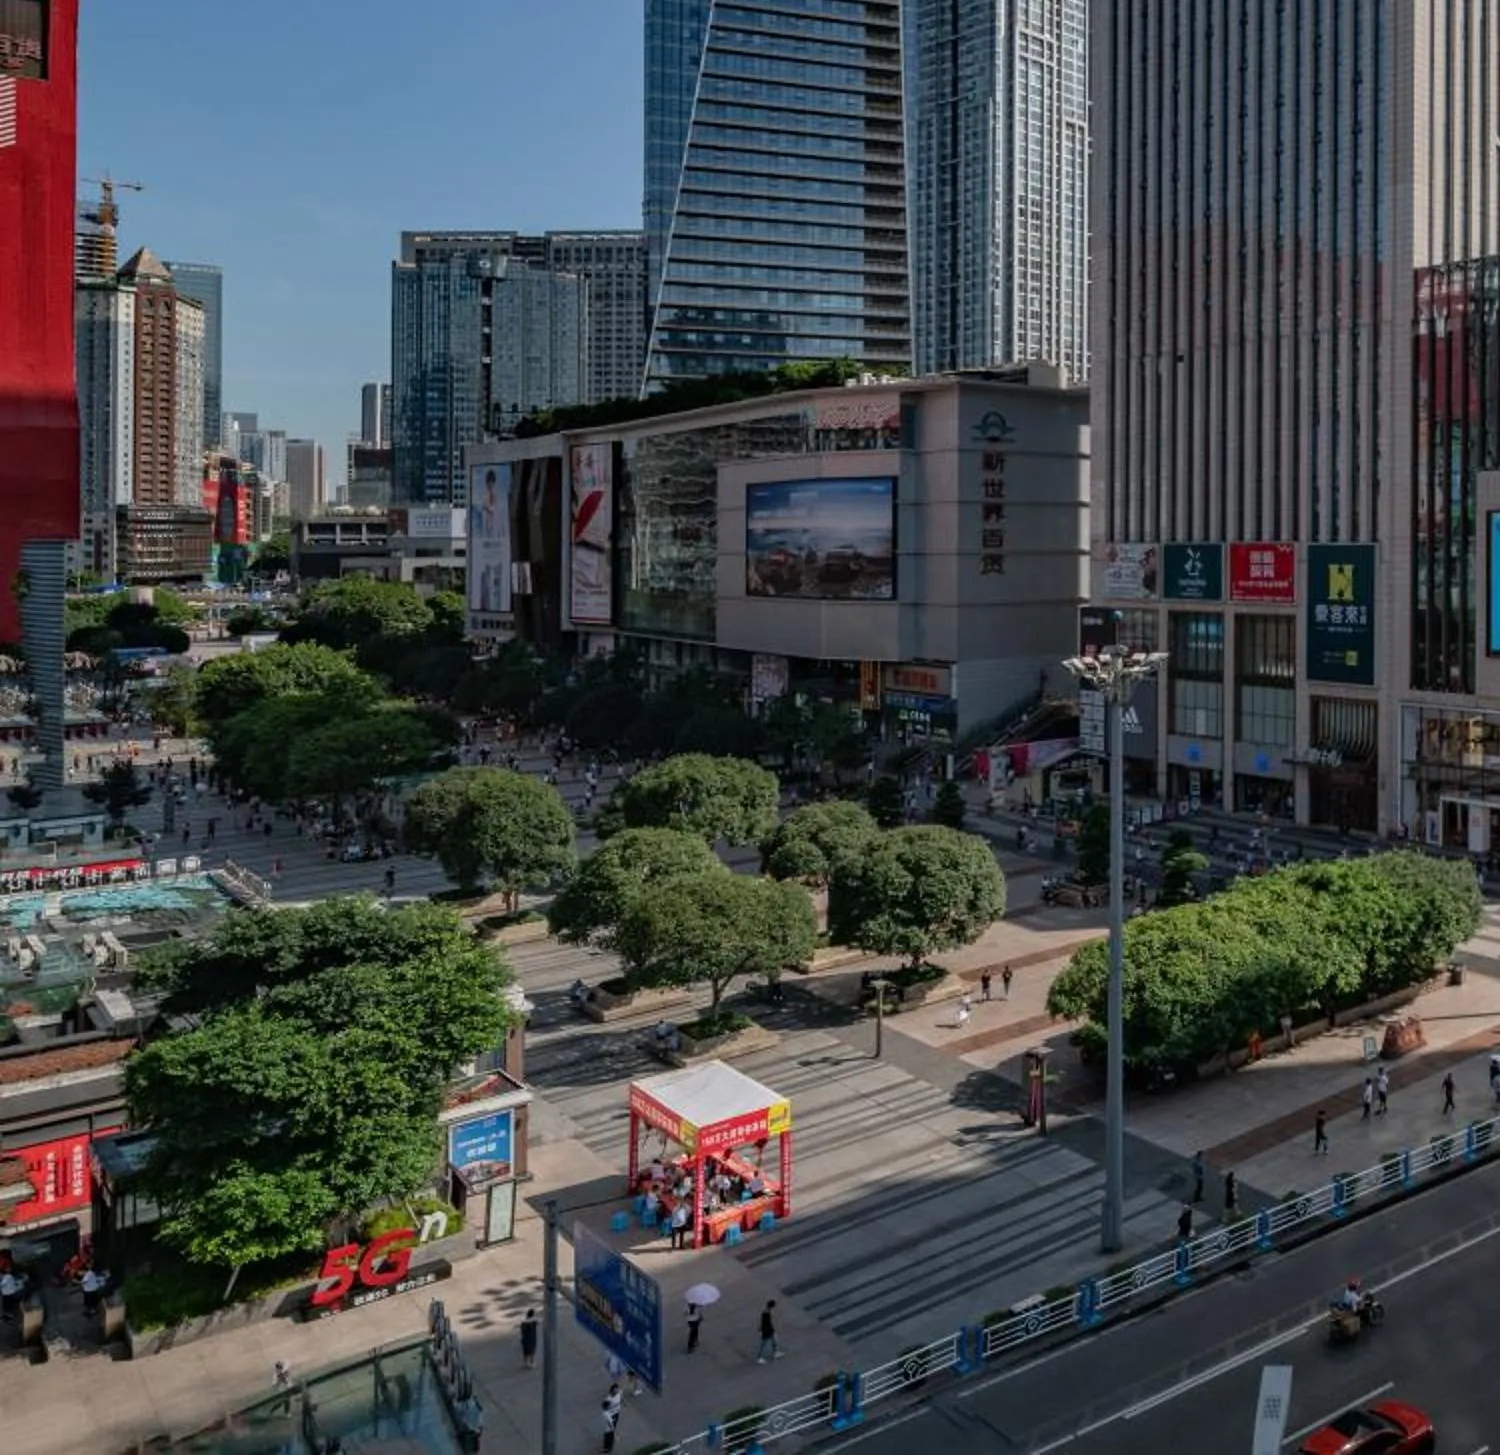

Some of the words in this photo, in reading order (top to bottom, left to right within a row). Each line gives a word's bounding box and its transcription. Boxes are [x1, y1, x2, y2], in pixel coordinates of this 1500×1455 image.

[981, 451, 1006, 575] 新世界百货
